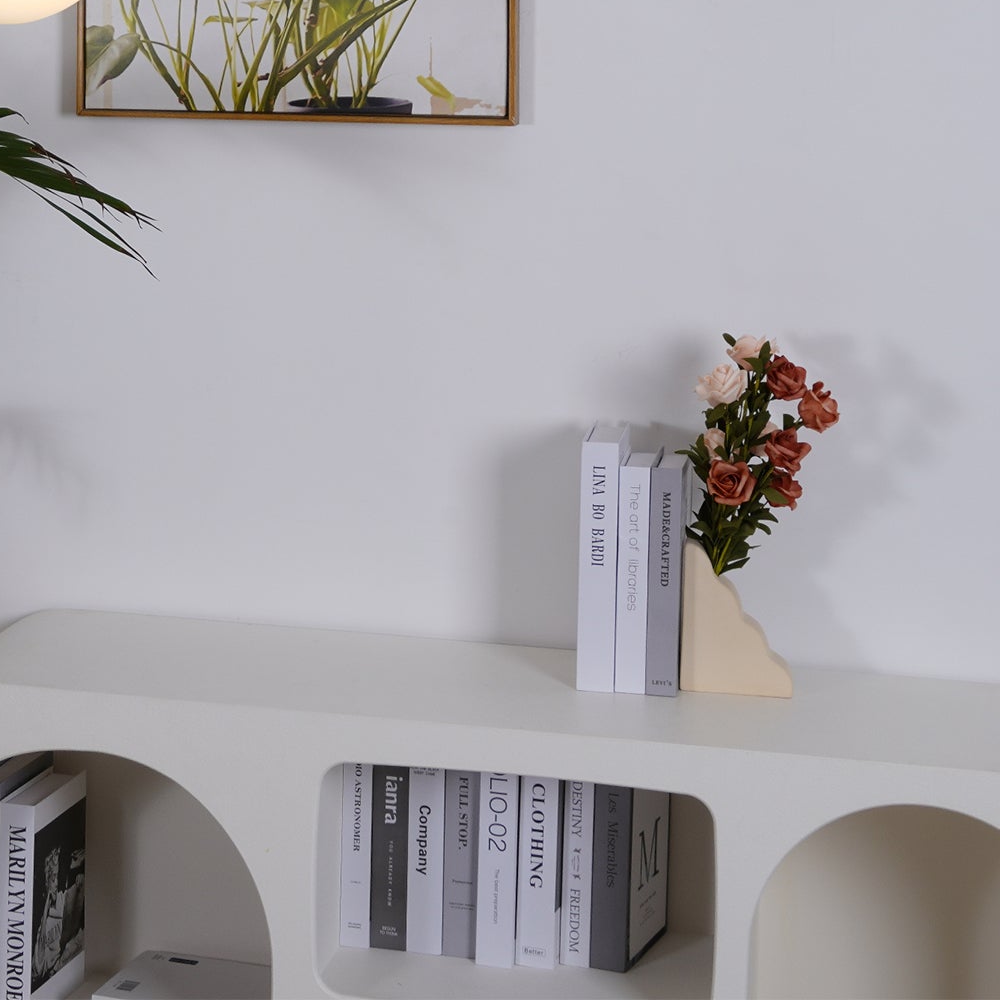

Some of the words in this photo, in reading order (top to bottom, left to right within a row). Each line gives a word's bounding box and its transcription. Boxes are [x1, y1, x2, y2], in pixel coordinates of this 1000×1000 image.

[592, 466, 606, 495] LINA
[629, 484, 641, 511] The
[592, 504, 605, 520] BO
[629, 515, 640, 534] art
[591, 528, 605, 567] BARDI
[629, 538, 640, 553] of
[660, 491, 672, 587] MADE&CRAFTED
[626, 559, 640, 611] libraries
[352, 779, 362, 852] ASTRONOMER
[385, 775, 404, 824] ianra
[459, 777, 469, 812] FULL
[570, 781, 583, 838] DESTINY
[607, 792, 619, 813] Les
[415, 805, 432, 876] Company
[529, 783, 546, 889] CLOTHING
[606, 820, 620, 888] Miserables
[8, 825, 27, 913] MARILYN
[569, 888, 581, 953] FREEDOM
[6, 918, 25, 1000] MONROE
